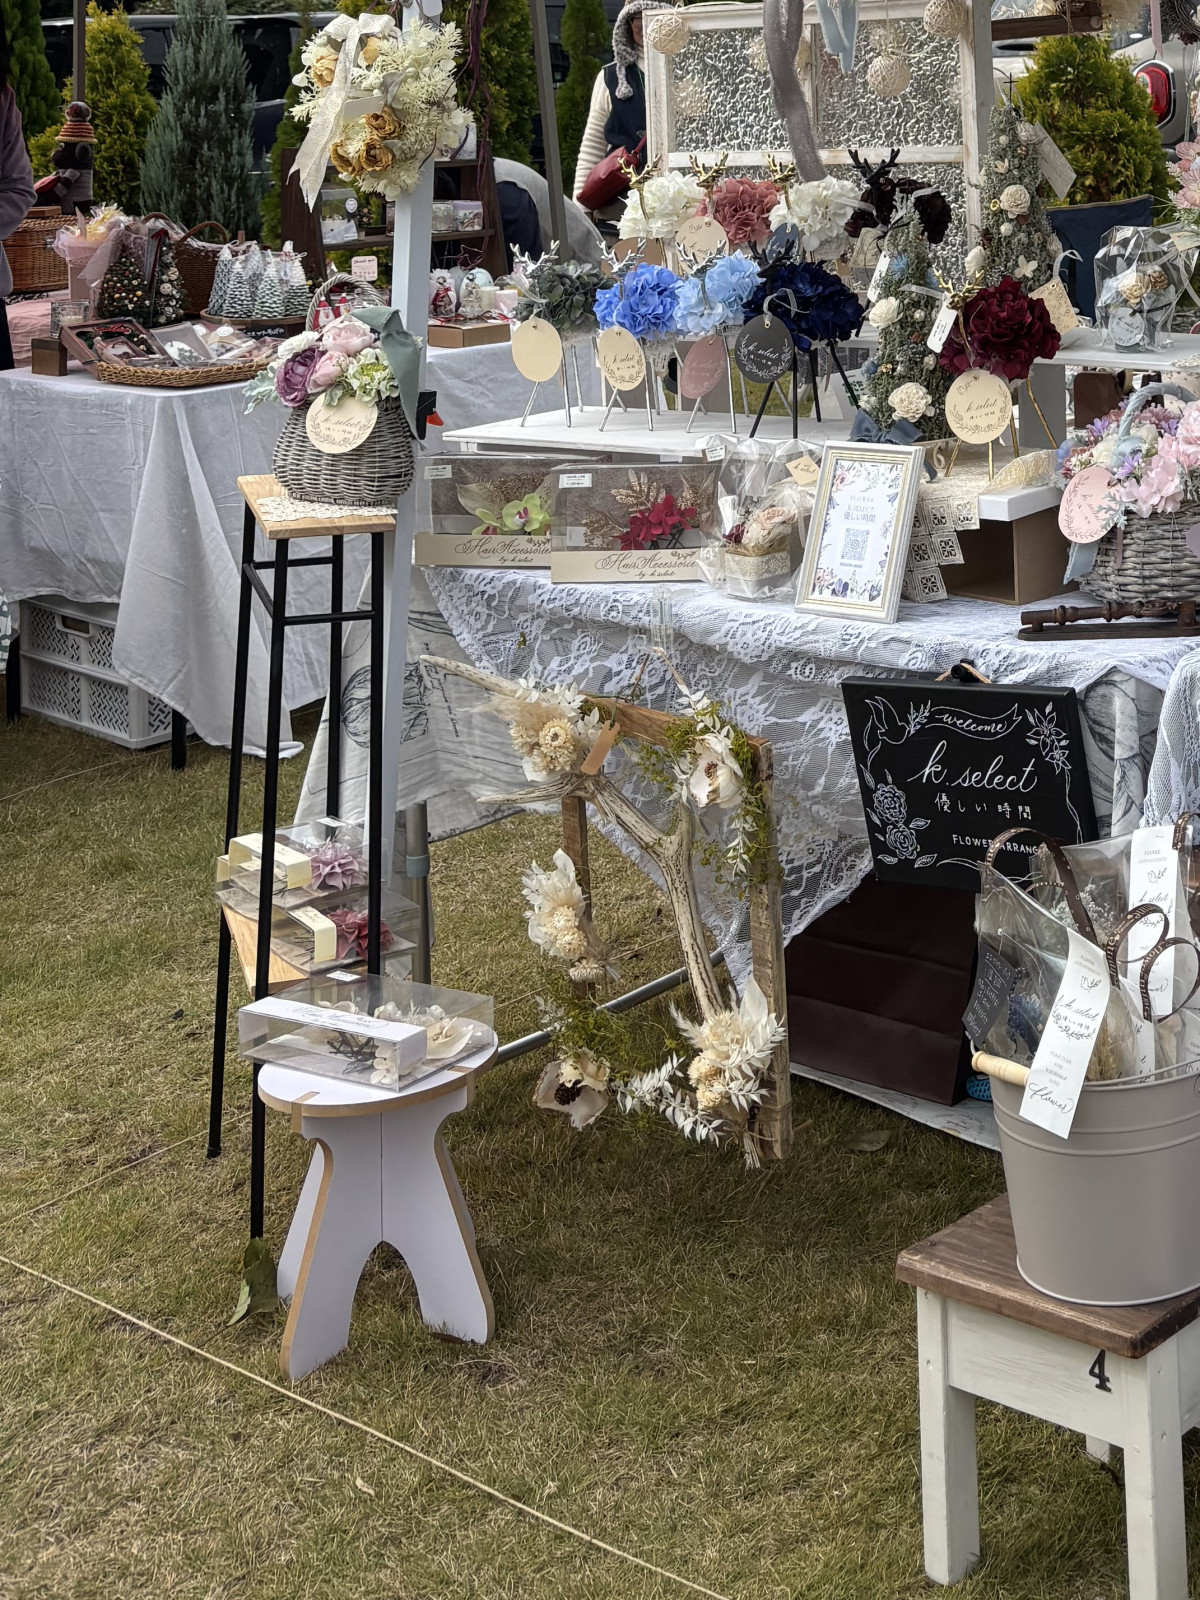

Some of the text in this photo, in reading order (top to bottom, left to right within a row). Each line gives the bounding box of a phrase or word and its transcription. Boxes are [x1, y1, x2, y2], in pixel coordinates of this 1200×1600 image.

[496, 538, 551, 555] Accessorie
[595, 552, 696, 574] Hair Accessorie
[935, 713, 1007, 733] welcome
[935, 792, 1033, 821] 優しい時間
[1088, 1350, 1112, 1393] 4
